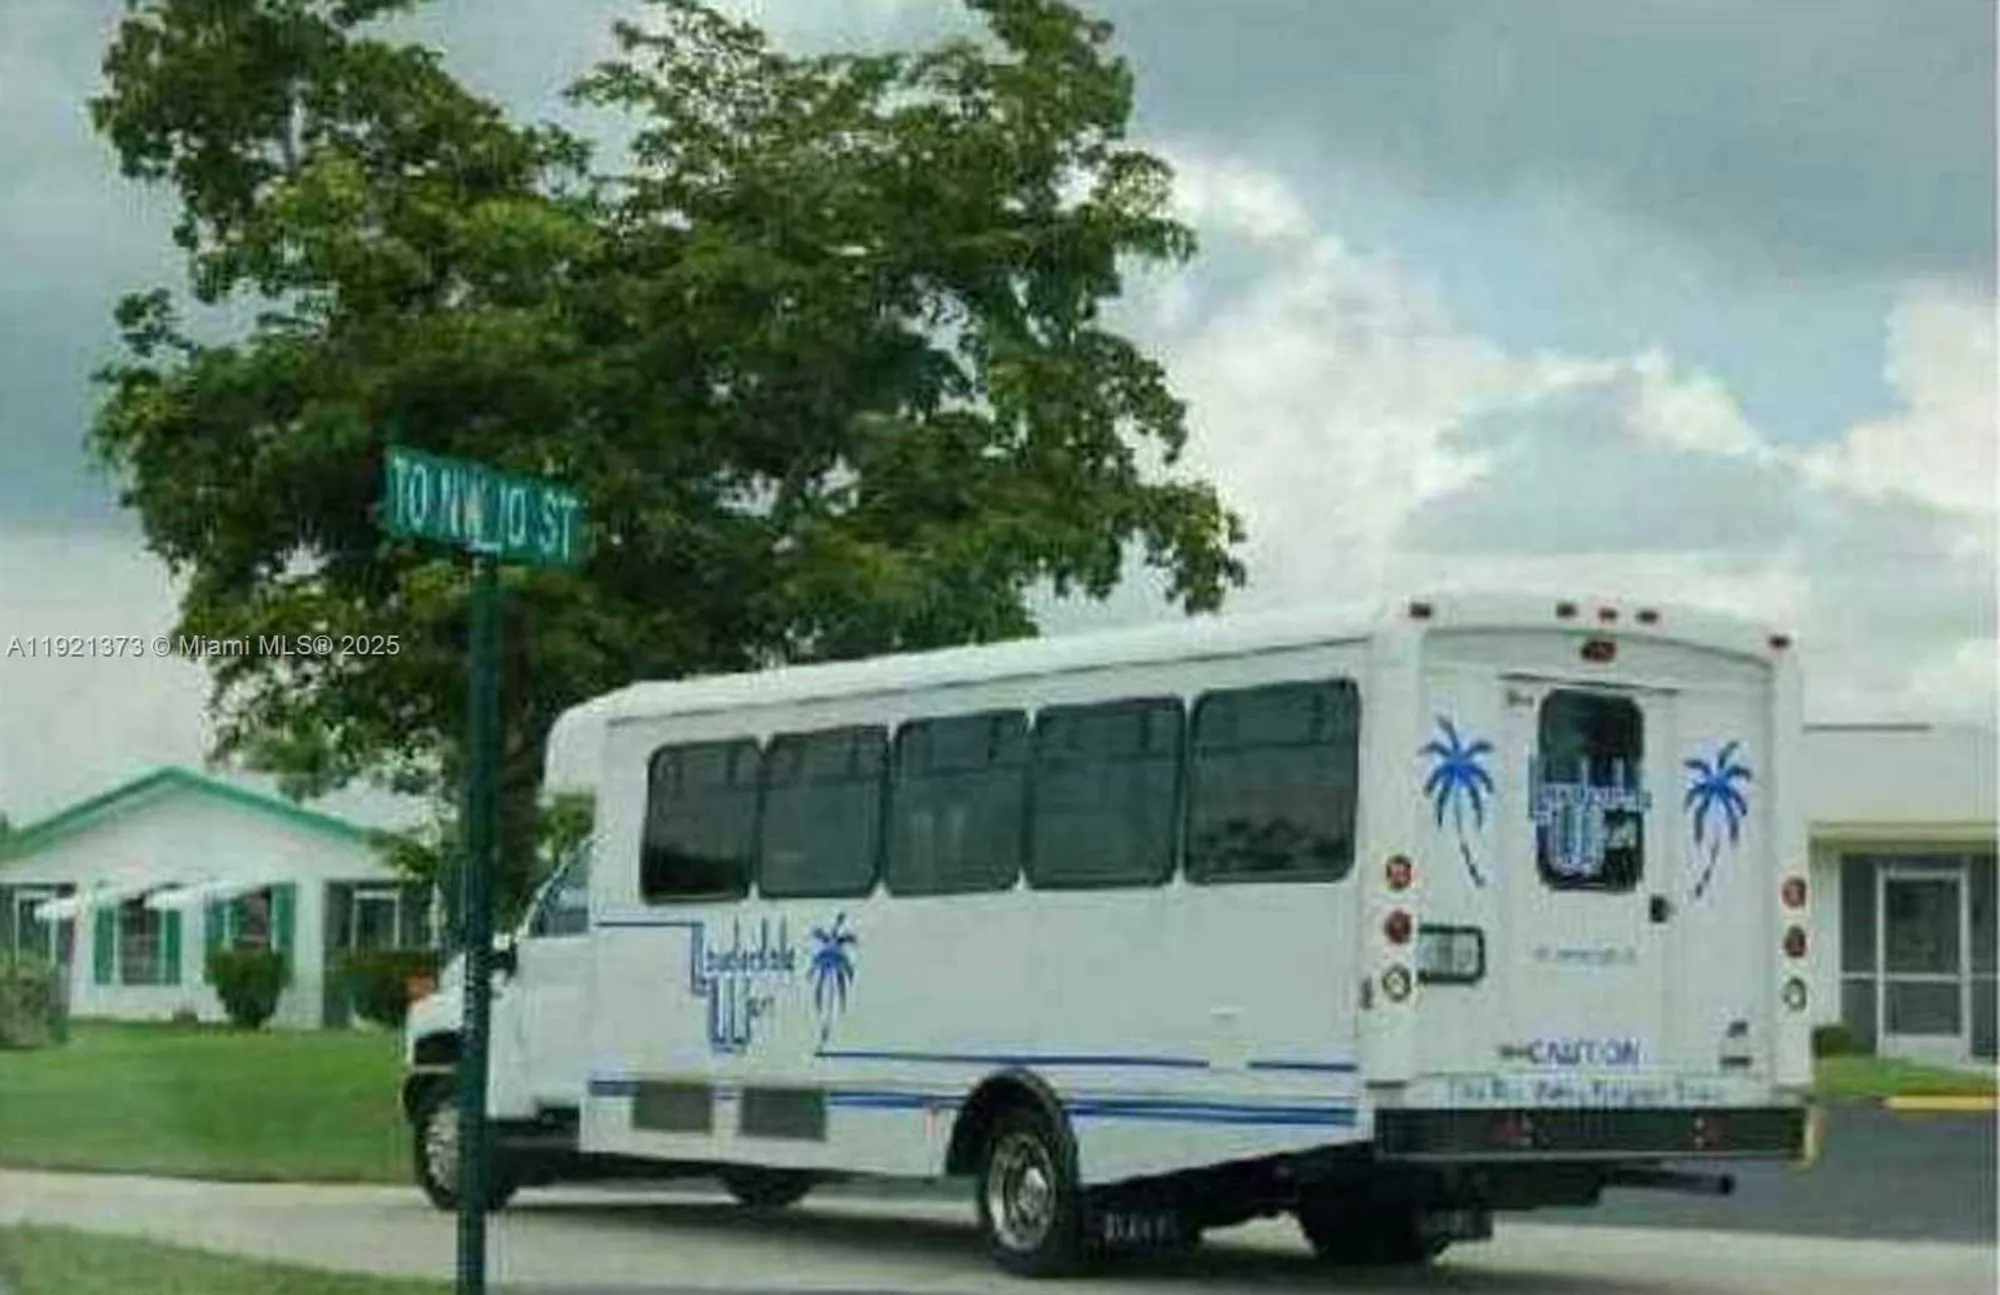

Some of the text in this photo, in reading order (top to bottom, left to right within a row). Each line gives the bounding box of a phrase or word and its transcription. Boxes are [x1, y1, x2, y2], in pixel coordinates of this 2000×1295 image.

[394, 456, 427, 533] TO
[499, 482, 527, 547] 10
[539, 490, 580, 564] ST
